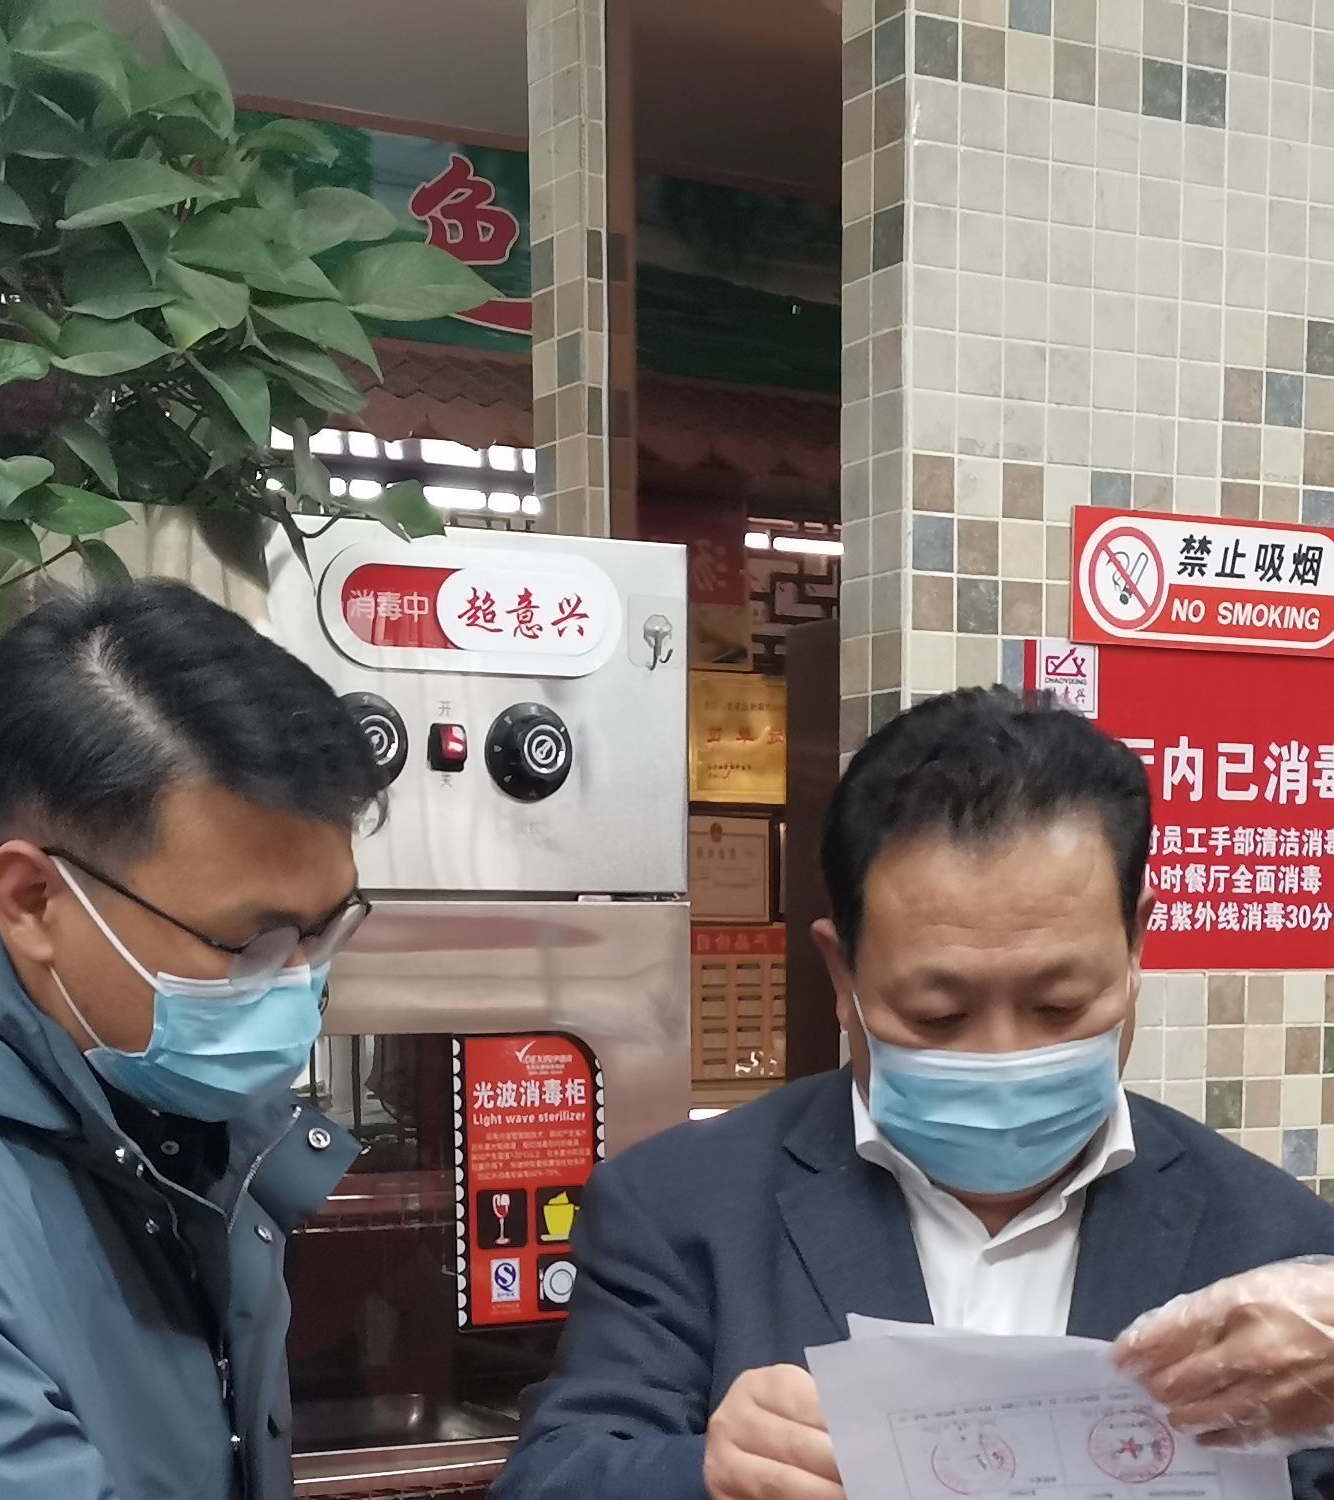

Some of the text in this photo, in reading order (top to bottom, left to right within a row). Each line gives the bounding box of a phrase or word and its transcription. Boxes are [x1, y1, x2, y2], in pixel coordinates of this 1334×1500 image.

[1177, 534, 1323, 587] 禁止吸烟
[349, 587, 590, 639] 消毒中 超意兴
[1171, 598, 1321, 631] NO SMOKING
[473, 1078, 586, 1109] 光波消毒柜
[473, 1111, 586, 1127] Light wave sterilizer
